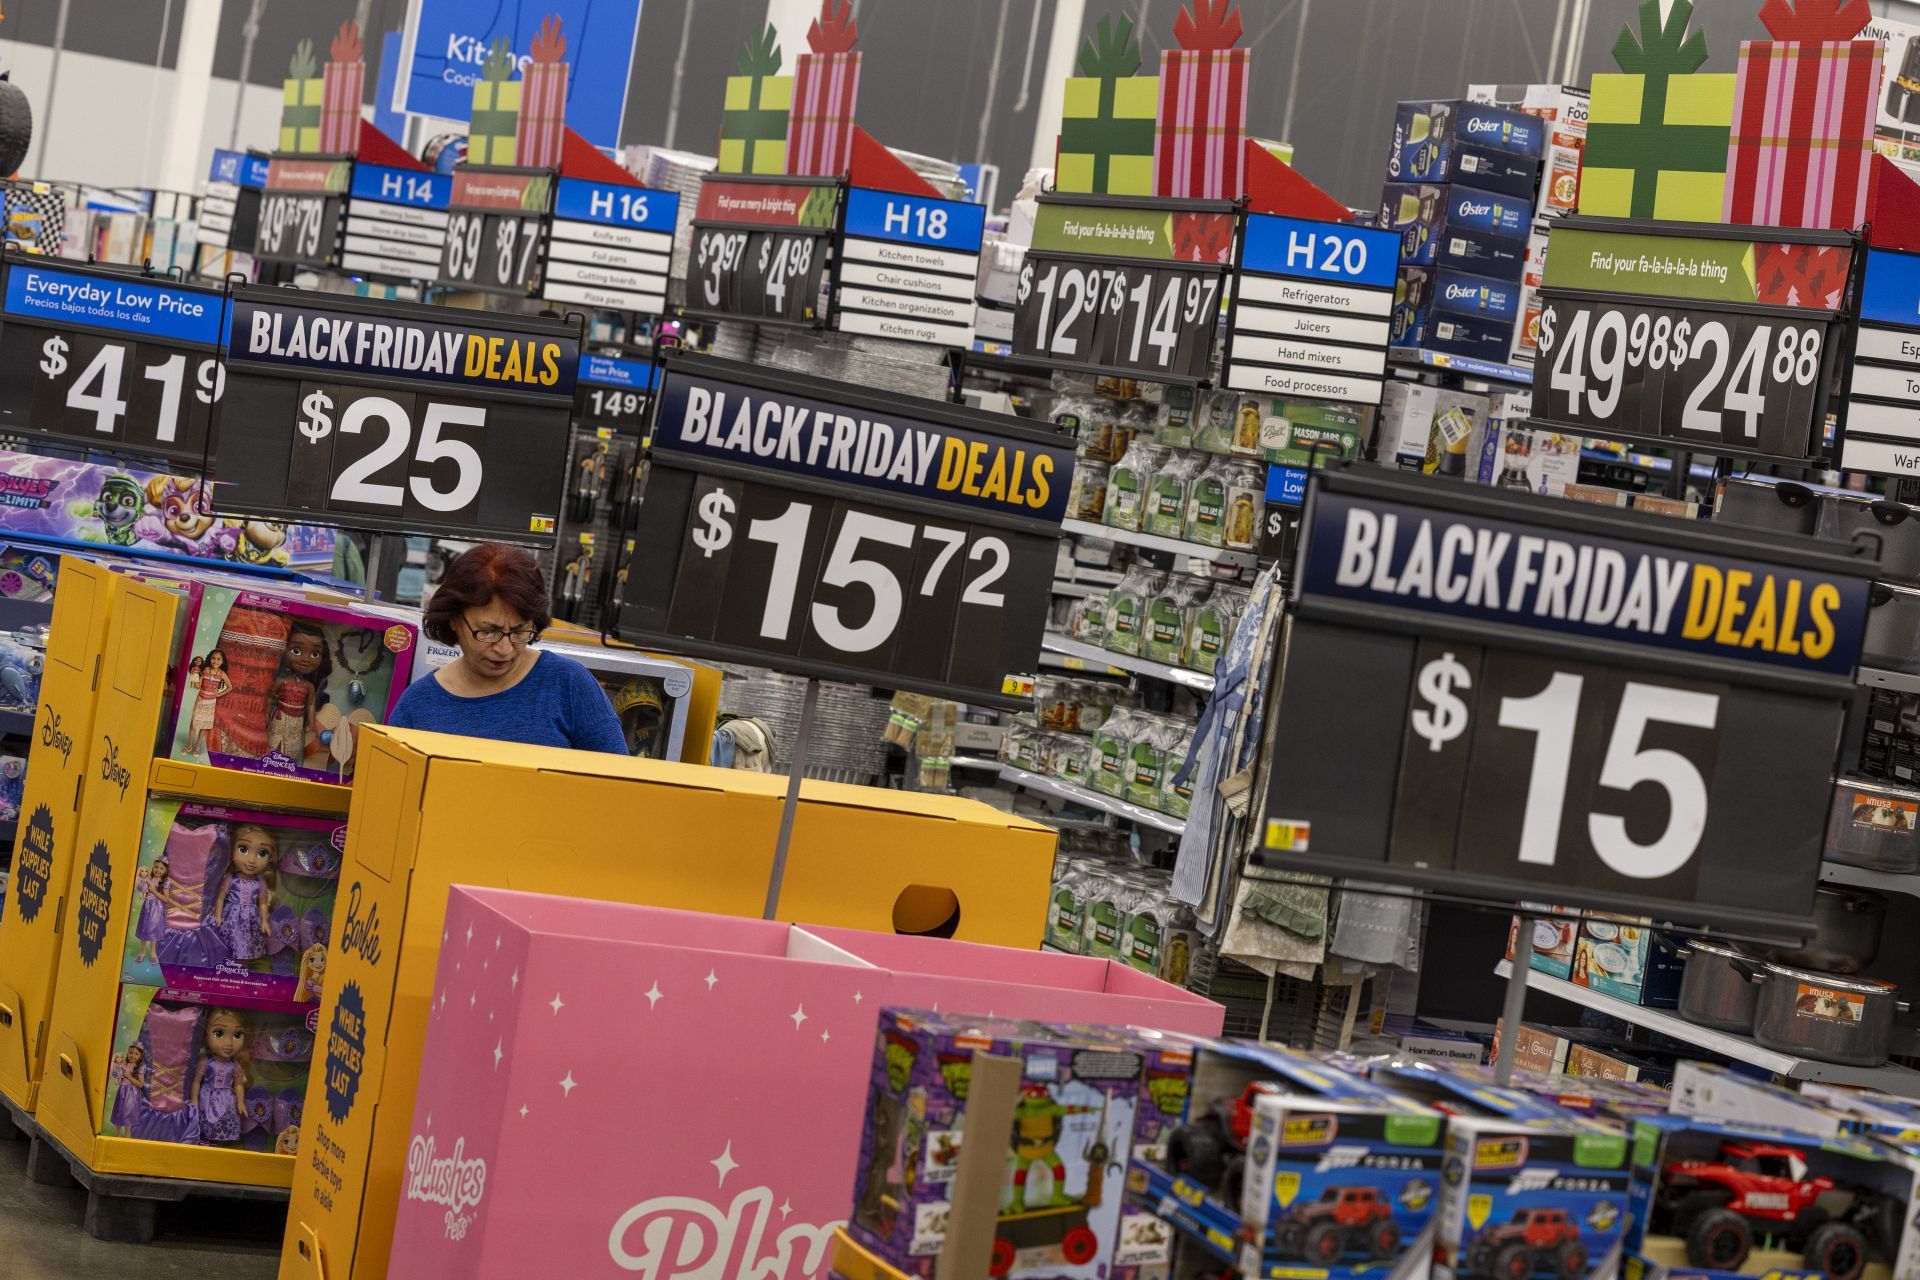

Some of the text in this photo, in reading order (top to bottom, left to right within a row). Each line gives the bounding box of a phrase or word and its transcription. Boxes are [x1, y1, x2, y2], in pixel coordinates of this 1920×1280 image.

[1467, 117, 1500, 133] Oster
[1389, 123, 1403, 177] Oster
[1459, 201, 1490, 216] Oster
[1063, 220, 1079, 235] Find
[1078, 224, 1095, 240] your
[1135, 228, 1155, 245] thing
[878, 248, 945, 267] Kitchen towels
[1590, 251, 1612, 270] Find
[1613, 257, 1637, 277] your
[1700, 260, 1728, 284] thing
[577, 271, 608, 286] Cutting
[876, 272, 942, 292] Chair cushions
[26, 274, 204, 317] Everyday Low Price
[1282, 287, 1351, 307] Refrigerators
[1446, 284, 1477, 300] Oster
[25, 296, 59, 310] Precios
[61, 302, 86, 315] bajos
[87, 305, 115, 318] todos
[117, 309, 130, 320] los
[861, 295, 955, 318] Kitchen organization
[879, 322, 937, 341] Kitchen rugs
[1294, 319, 1331, 334] Juicers
[249, 310, 560, 386] BLACK FRIDAY DEALS
[1278, 346, 1341, 365] Hand mixers
[590, 364, 606, 375] Low
[608, 367, 630, 379] Price
[1265, 375, 1348, 396] Food processors
[1294, 427, 1319, 440] MASON
[298, 390, 486, 512] $25
[680, 386, 1054, 509] BLACK FRIDAY DEALS
[1284, 480, 1305, 494] Low
[1336, 507, 1840, 659] BLACK FRIDAY DEALS
[101, 735, 130, 803] Disney
[1411, 651, 1720, 879] $15
[1866, 797, 1892, 809] imusa
[30, 823, 51, 851] WHILE
[22, 848, 51, 881] SUPPLIES
[89, 862, 108, 891] WHILE
[22, 875, 40, 901] LAST
[82, 886, 109, 922] SUPPLIES
[83, 915, 98, 943] LAST
[1809, 988, 1834, 999] imusa
[339, 1004, 361, 1041] WHILE
[330, 1031, 361, 1074] SUPPLIES
[1408, 1045, 1477, 1061] Hamilton Beach
[331, 1065, 350, 1098] LAST
[316, 1124, 346, 1164] Shop more
[312, 1149, 342, 1194] Barbie toys
[408, 1135, 486, 1213] Plushes
[1363, 1155, 1424, 1170] FORZA
[314, 1182, 333, 1213] in aisle
[1553, 1178, 1610, 1191] FORZA
[444, 1211, 468, 1241] Pets
